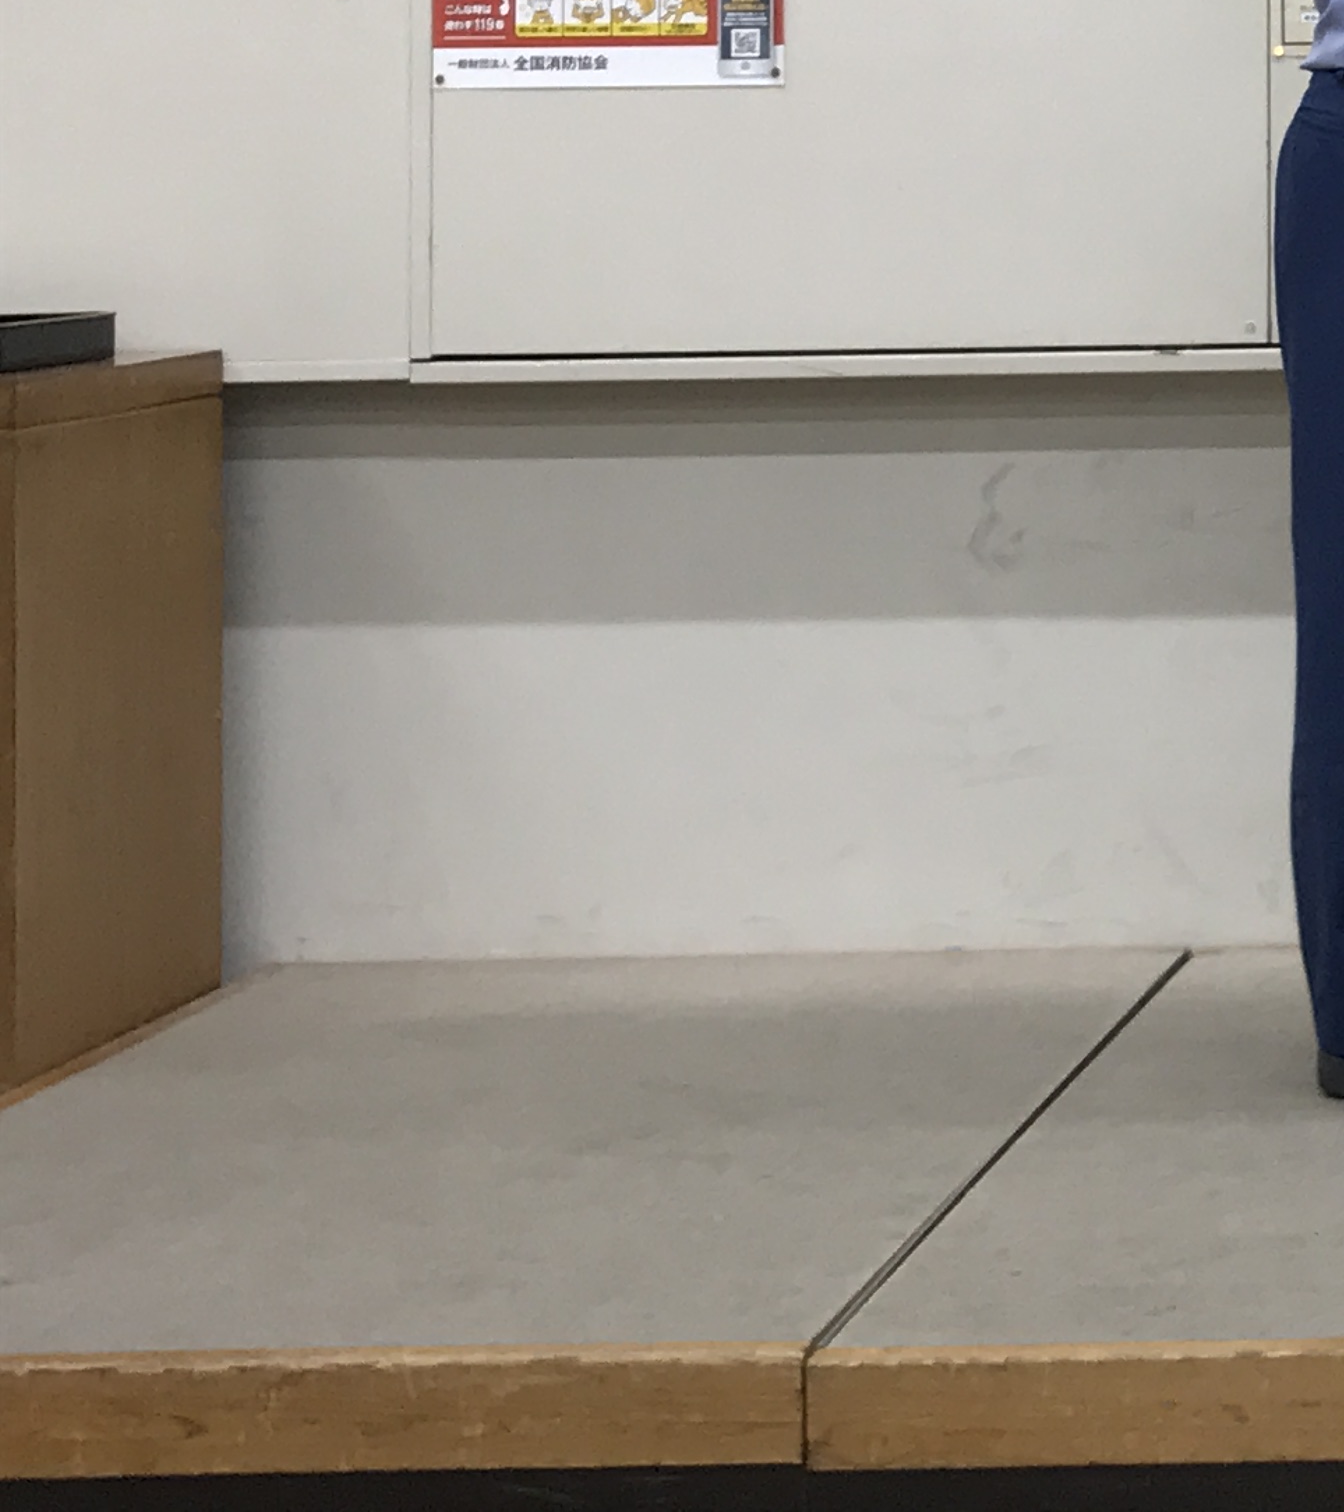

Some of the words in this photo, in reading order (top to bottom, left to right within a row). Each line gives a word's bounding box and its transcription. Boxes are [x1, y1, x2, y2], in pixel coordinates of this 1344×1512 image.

[513, 54, 609, 72] 全国消防協会
